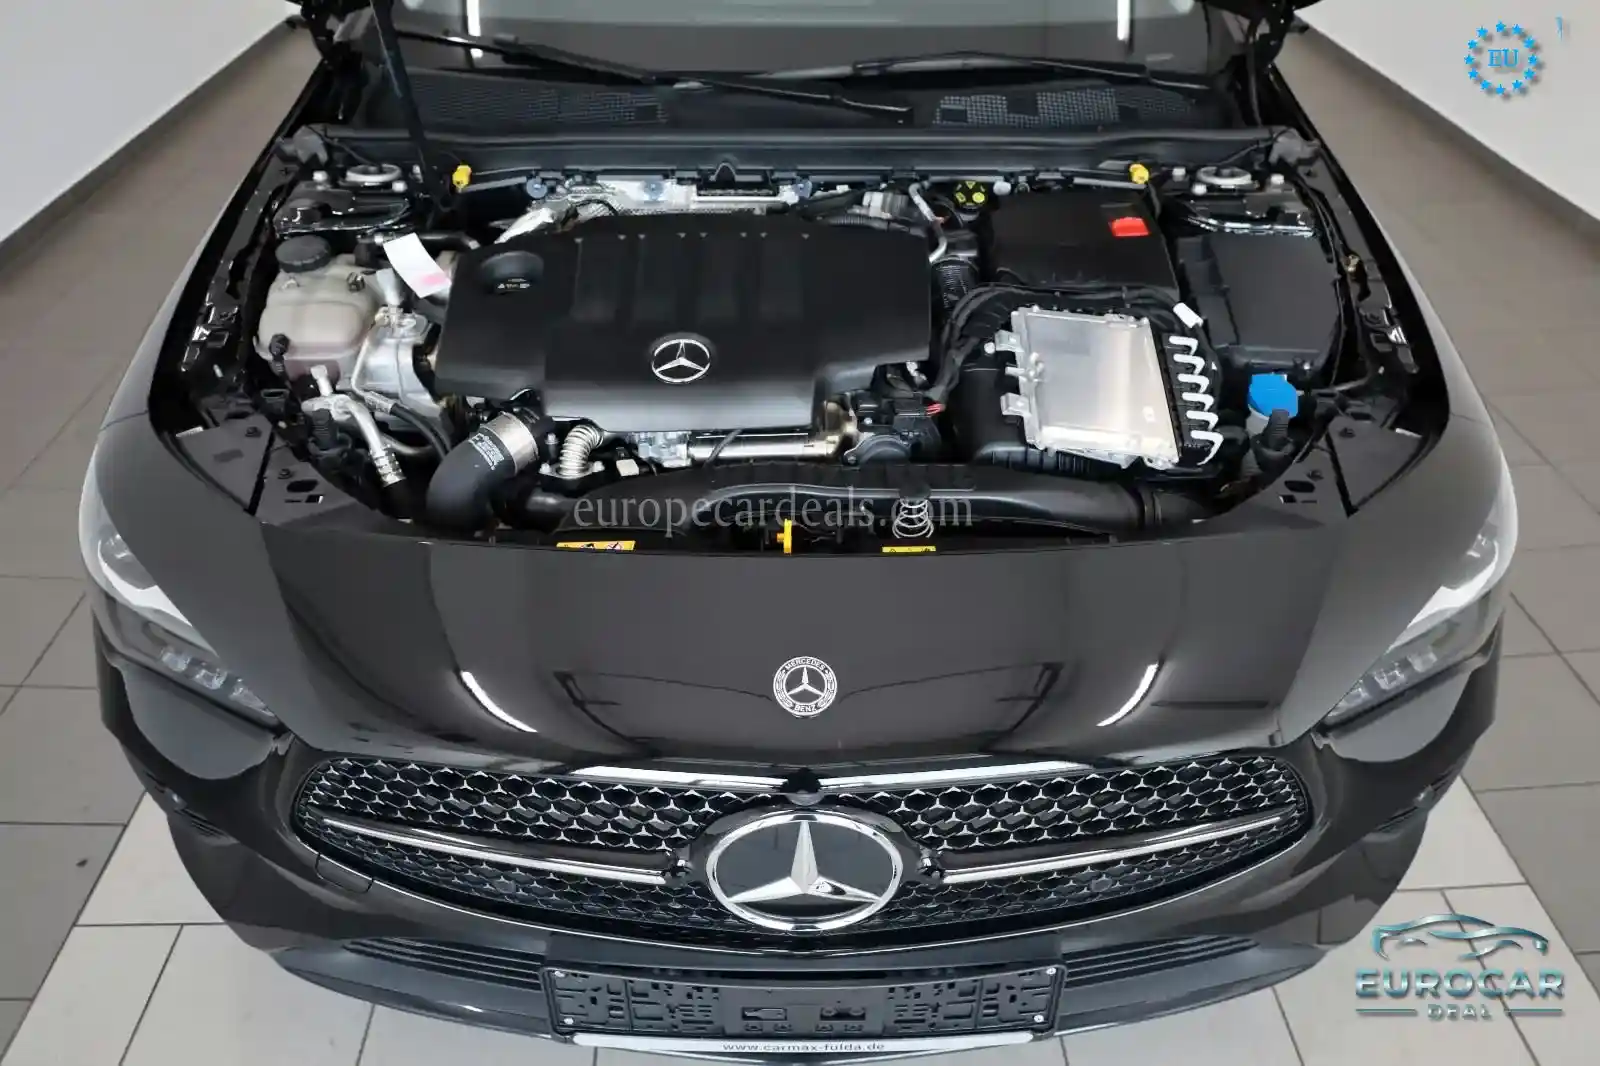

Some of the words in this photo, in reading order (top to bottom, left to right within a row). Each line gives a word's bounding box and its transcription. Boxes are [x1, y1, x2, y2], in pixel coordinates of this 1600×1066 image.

[785, 658, 826, 670] MERCEDES
[794, 704, 817, 712] BENZ
[722, 1042, 885, 1052] www.carmax-fulda.de
